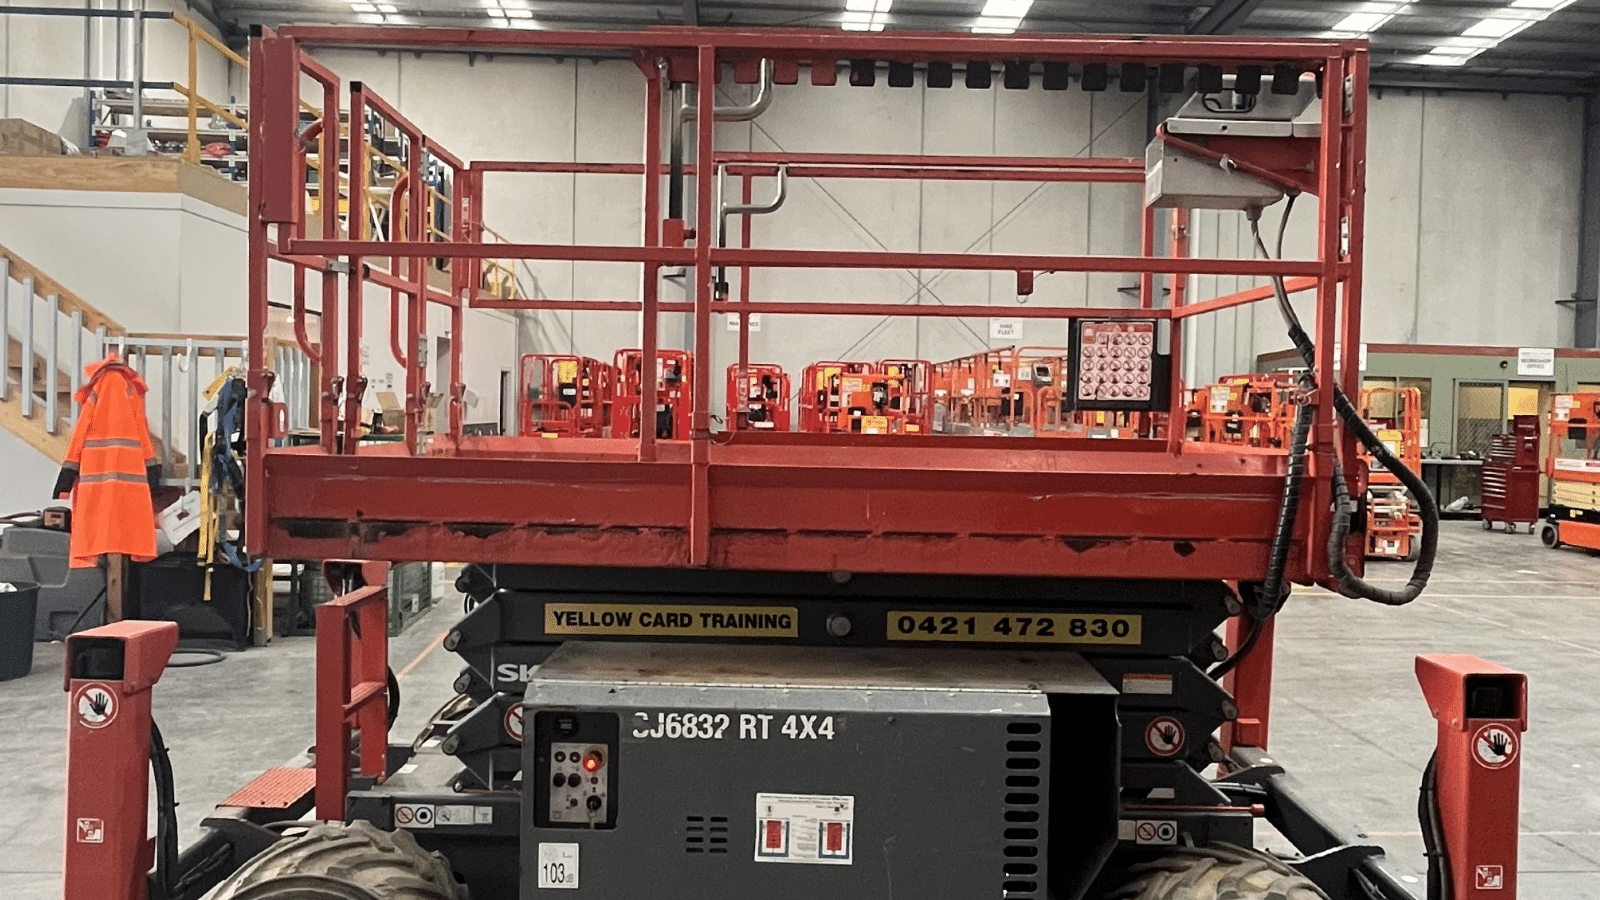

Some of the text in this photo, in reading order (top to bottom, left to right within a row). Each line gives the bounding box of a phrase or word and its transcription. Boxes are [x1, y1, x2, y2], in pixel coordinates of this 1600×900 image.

[553, 611, 791, 629] YELLOW CARD TRAINING
[897, 615, 1130, 637] 0421 472 830
[739, 713, 773, 740] RT
[781, 714, 835, 740] 4X4
[543, 863, 565, 883] 103
